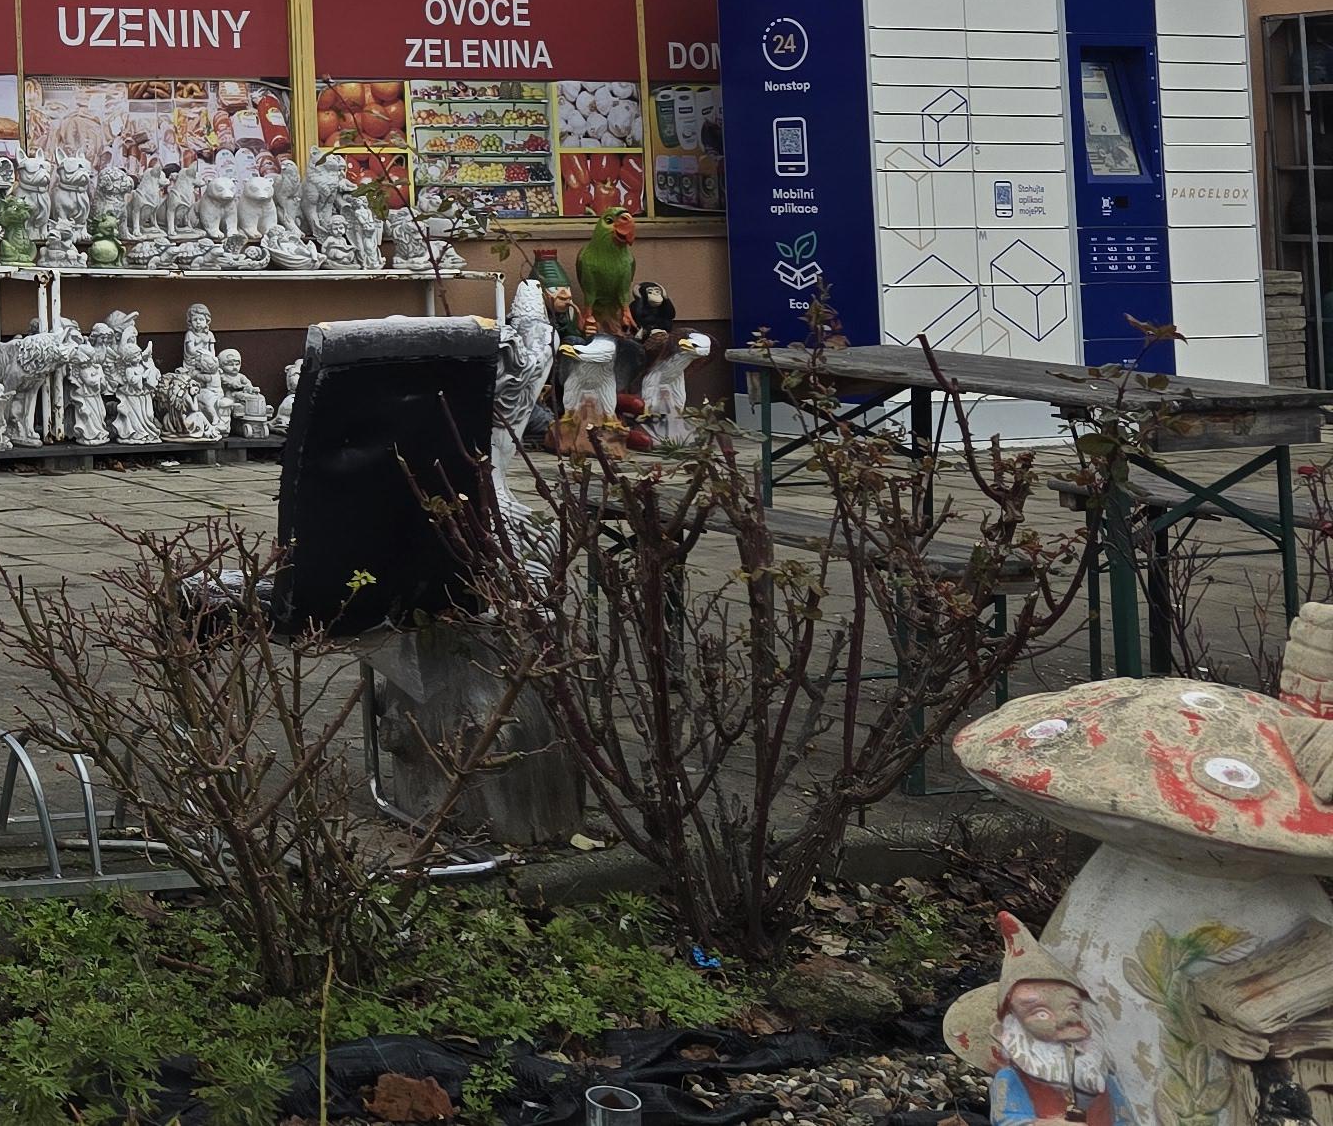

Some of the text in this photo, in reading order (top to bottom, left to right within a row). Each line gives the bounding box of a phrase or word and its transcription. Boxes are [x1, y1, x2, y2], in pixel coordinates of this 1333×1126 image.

[57, 7, 251, 48] UZENINY
[773, 33, 796, 53] 24
[405, 38, 553, 70] ZELENINA
[765, 81, 811, 92] Nonstop
[975, 146, 981, 155] S
[773, 188, 814, 200] Mobilní
[1171, 188, 1249, 199] PARCELBOX
[770, 202, 819, 215] aplikace
[979, 231, 987, 240] M
[789, 298, 810, 310] Eco
